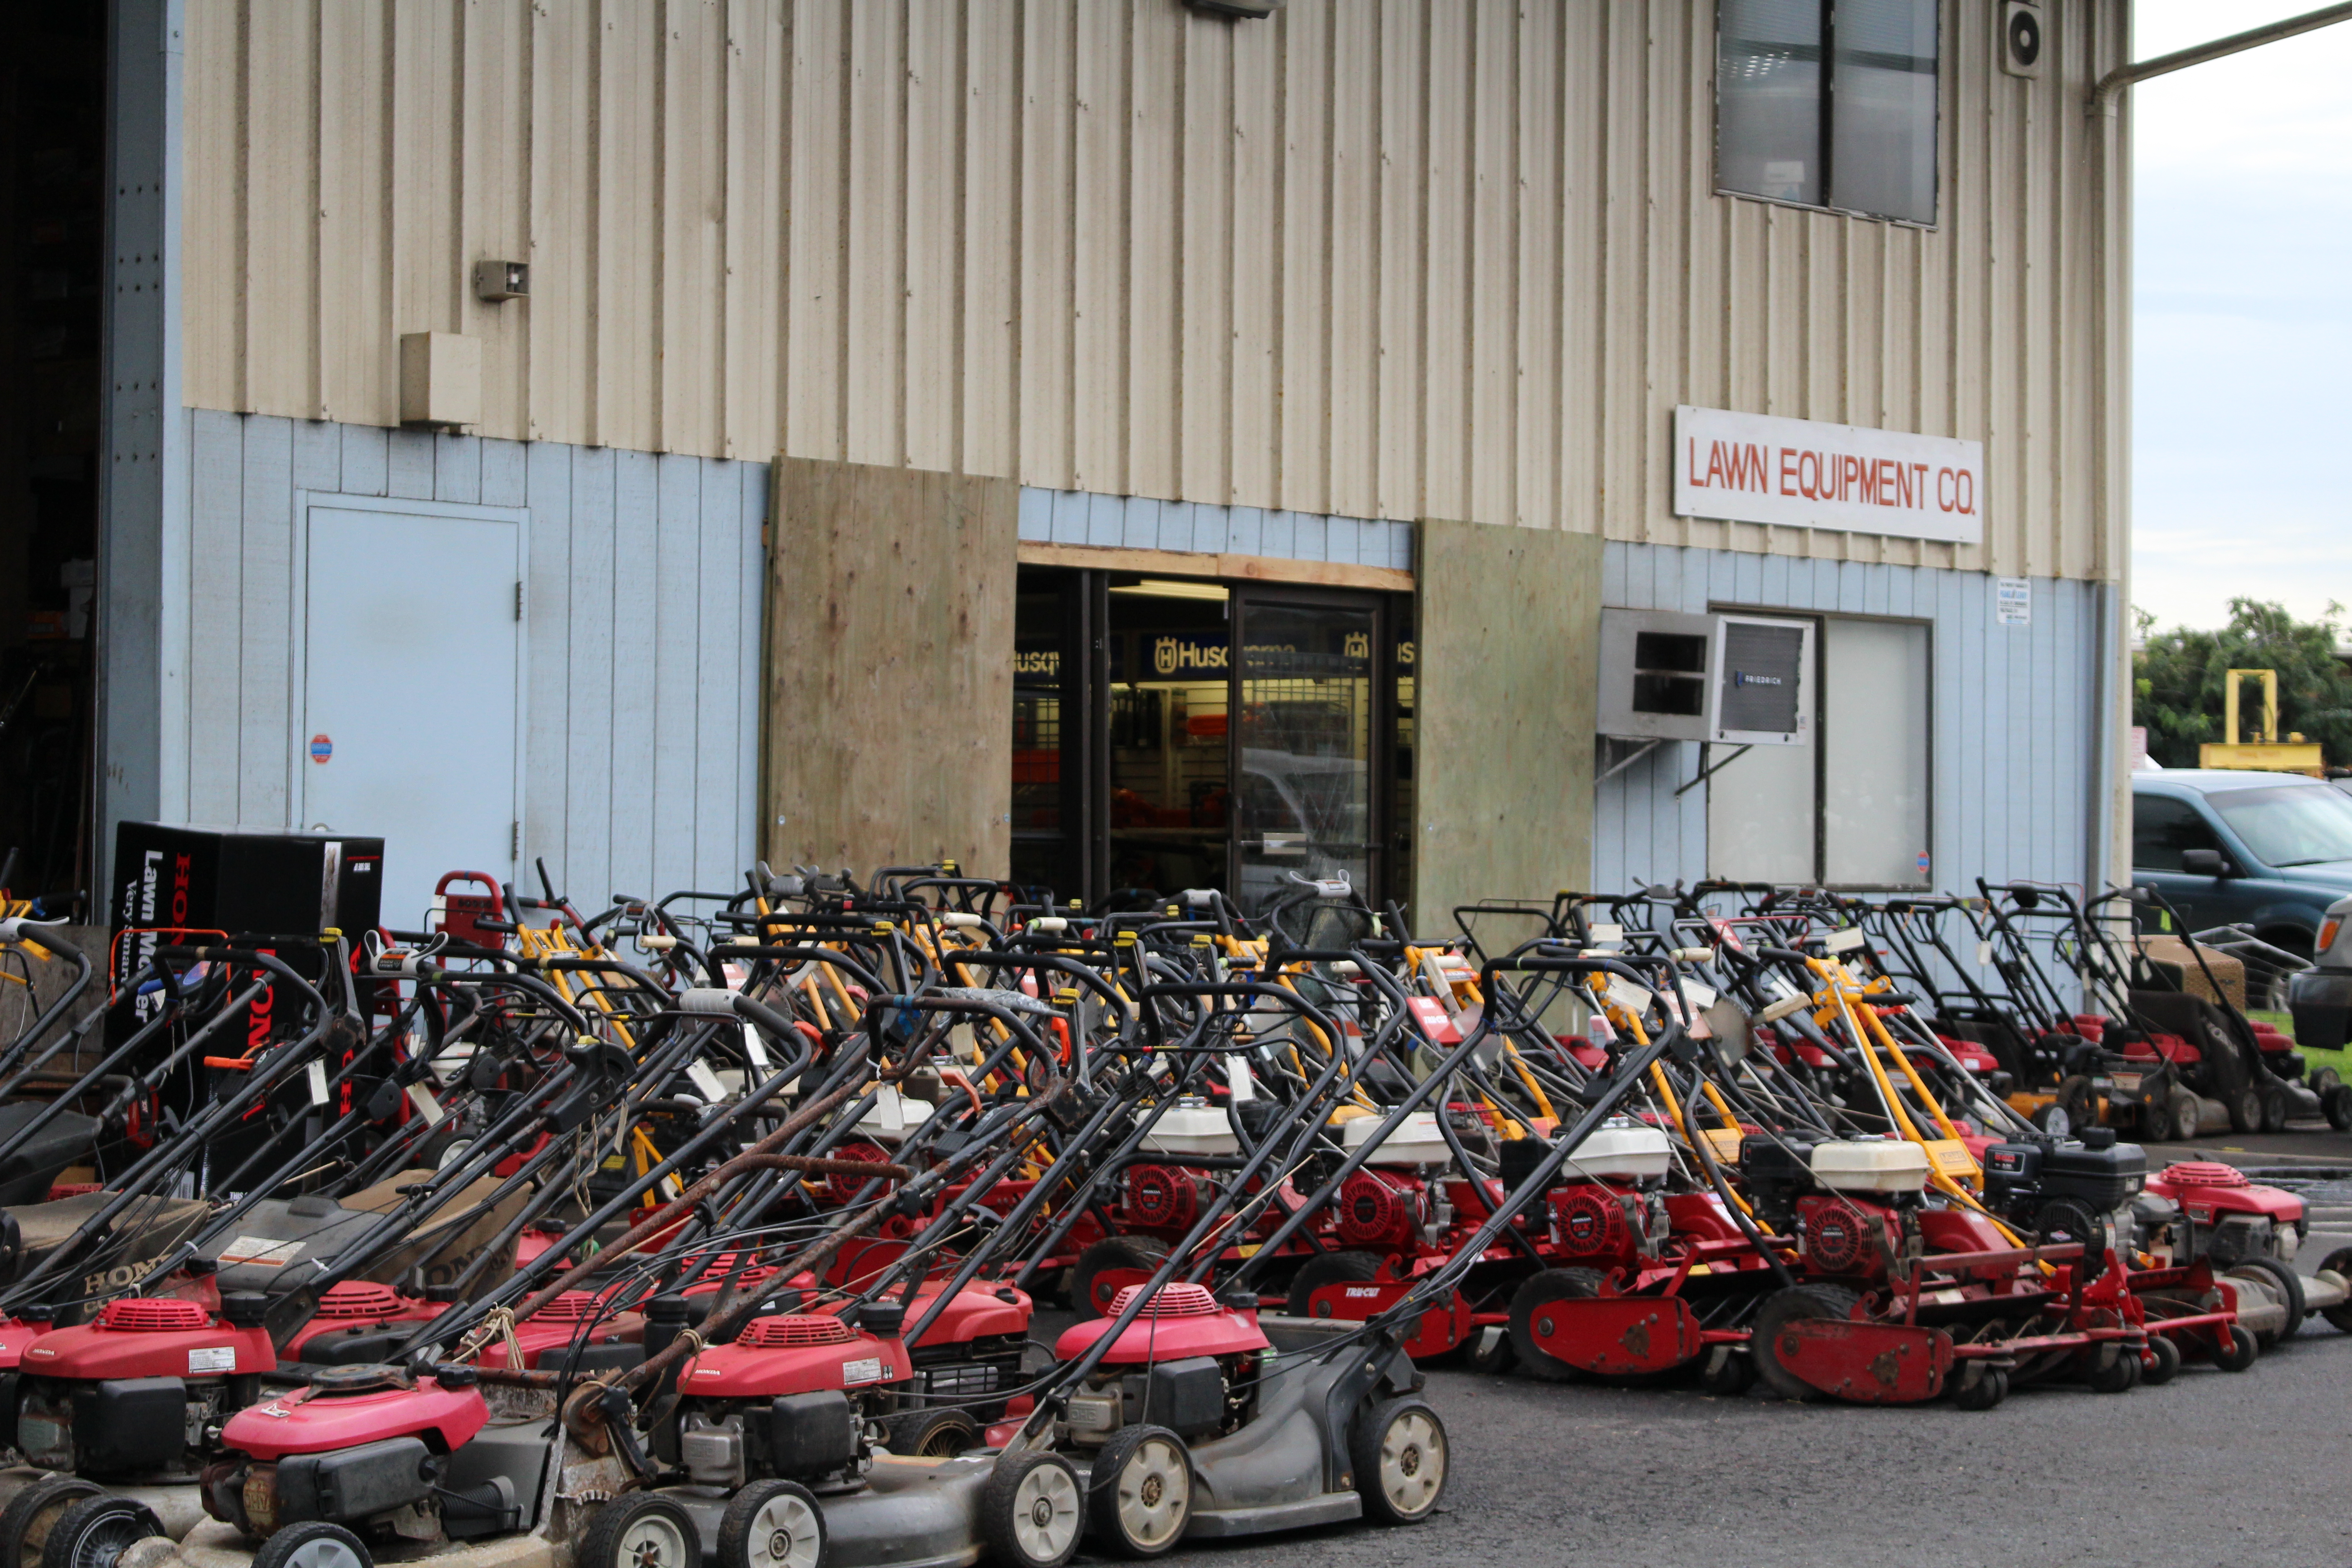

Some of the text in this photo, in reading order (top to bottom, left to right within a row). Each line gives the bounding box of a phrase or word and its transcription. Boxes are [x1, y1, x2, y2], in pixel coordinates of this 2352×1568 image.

[1689, 436, 1976, 516] LAWN EQUIPMENT CO.
[122, 879, 137, 922] Very
[135, 850, 163, 1023] Lawn Moer
[1143, 1195, 1160, 1203] GX
[1573, 1223, 1591, 1232] GX
[1345, 1287, 1380, 1298] TRU-CUT
[32, 1348, 55, 1356] HONDA
